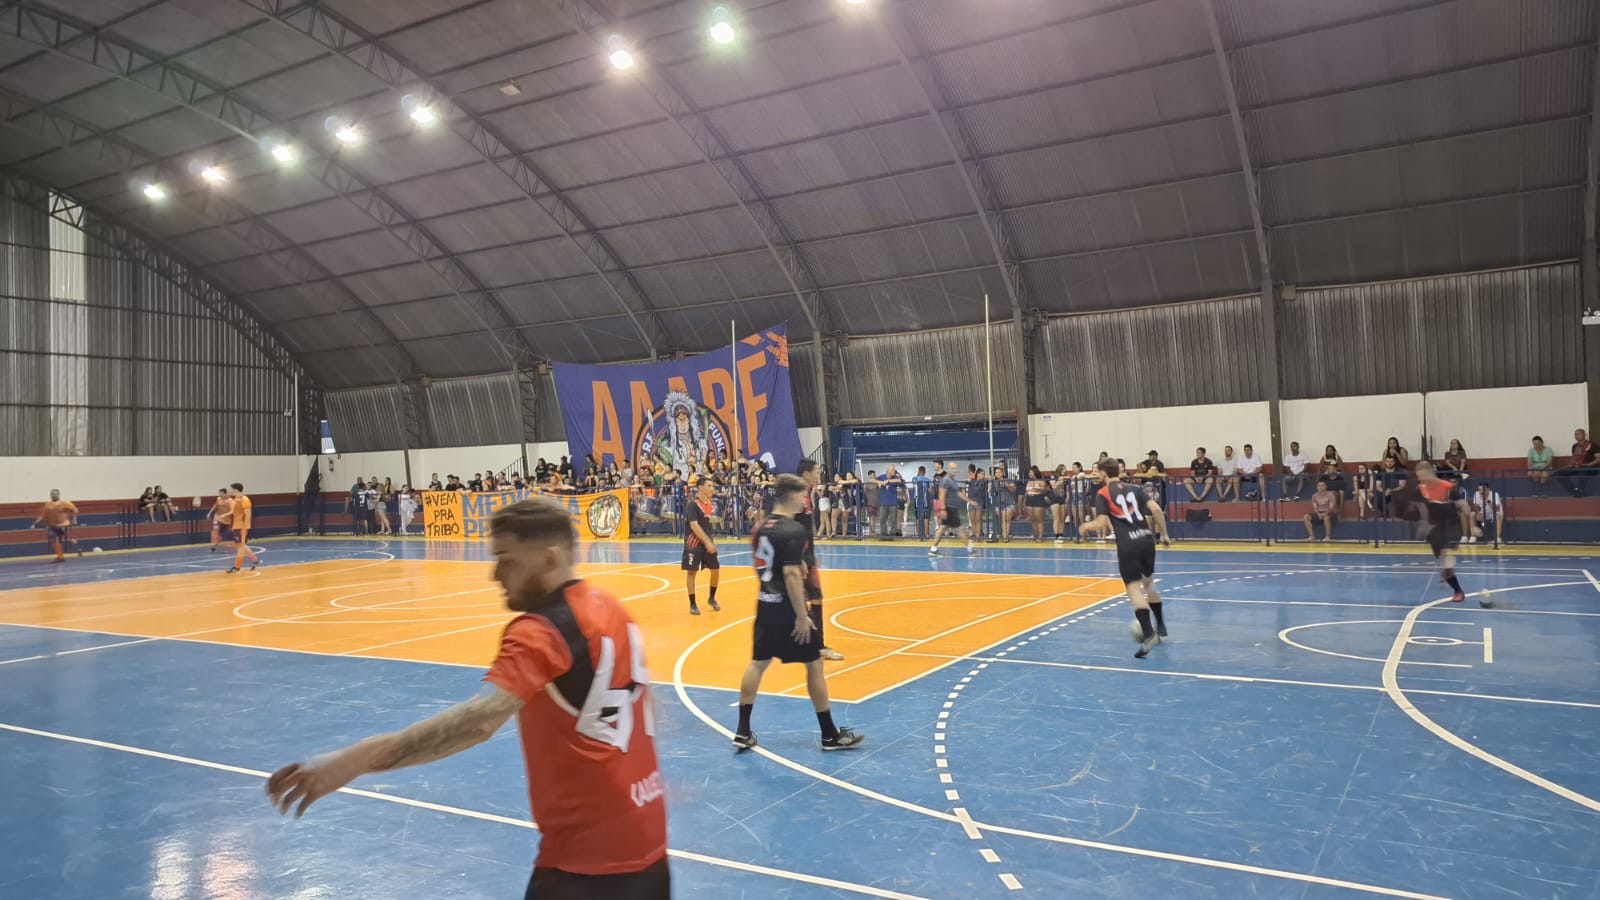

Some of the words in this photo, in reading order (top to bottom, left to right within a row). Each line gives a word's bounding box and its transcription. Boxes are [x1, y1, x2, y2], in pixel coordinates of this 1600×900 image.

[425, 492, 458, 507] #VEM
[434, 508, 455, 521] PRA
[1115, 491, 1145, 524] 11
[426, 522, 460, 537] TRIBO
